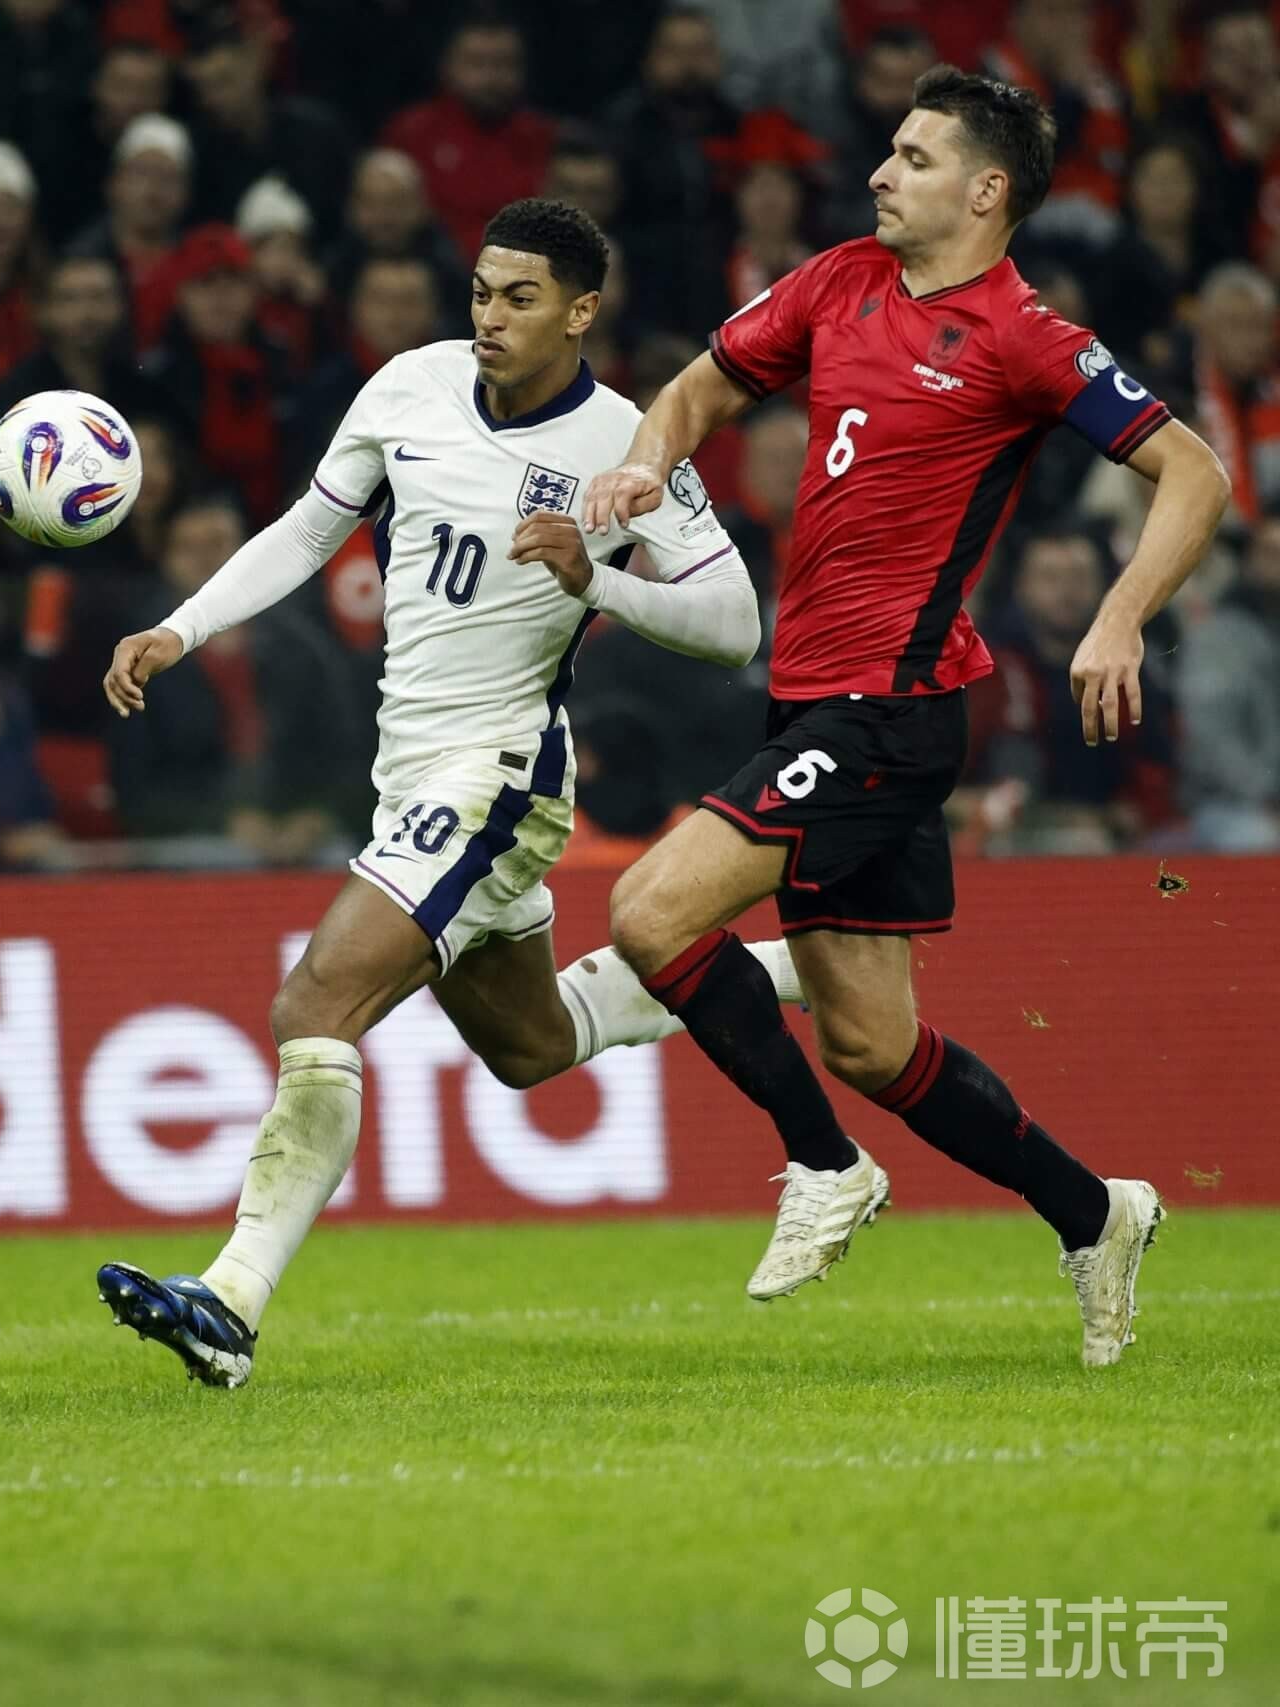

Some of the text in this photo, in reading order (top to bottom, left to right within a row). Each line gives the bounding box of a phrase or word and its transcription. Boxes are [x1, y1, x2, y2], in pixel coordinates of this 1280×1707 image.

[825, 408, 868, 478] 6
[426, 523, 487, 609] 10
[776, 749, 838, 800] 6
[390, 804, 462, 856] 10
